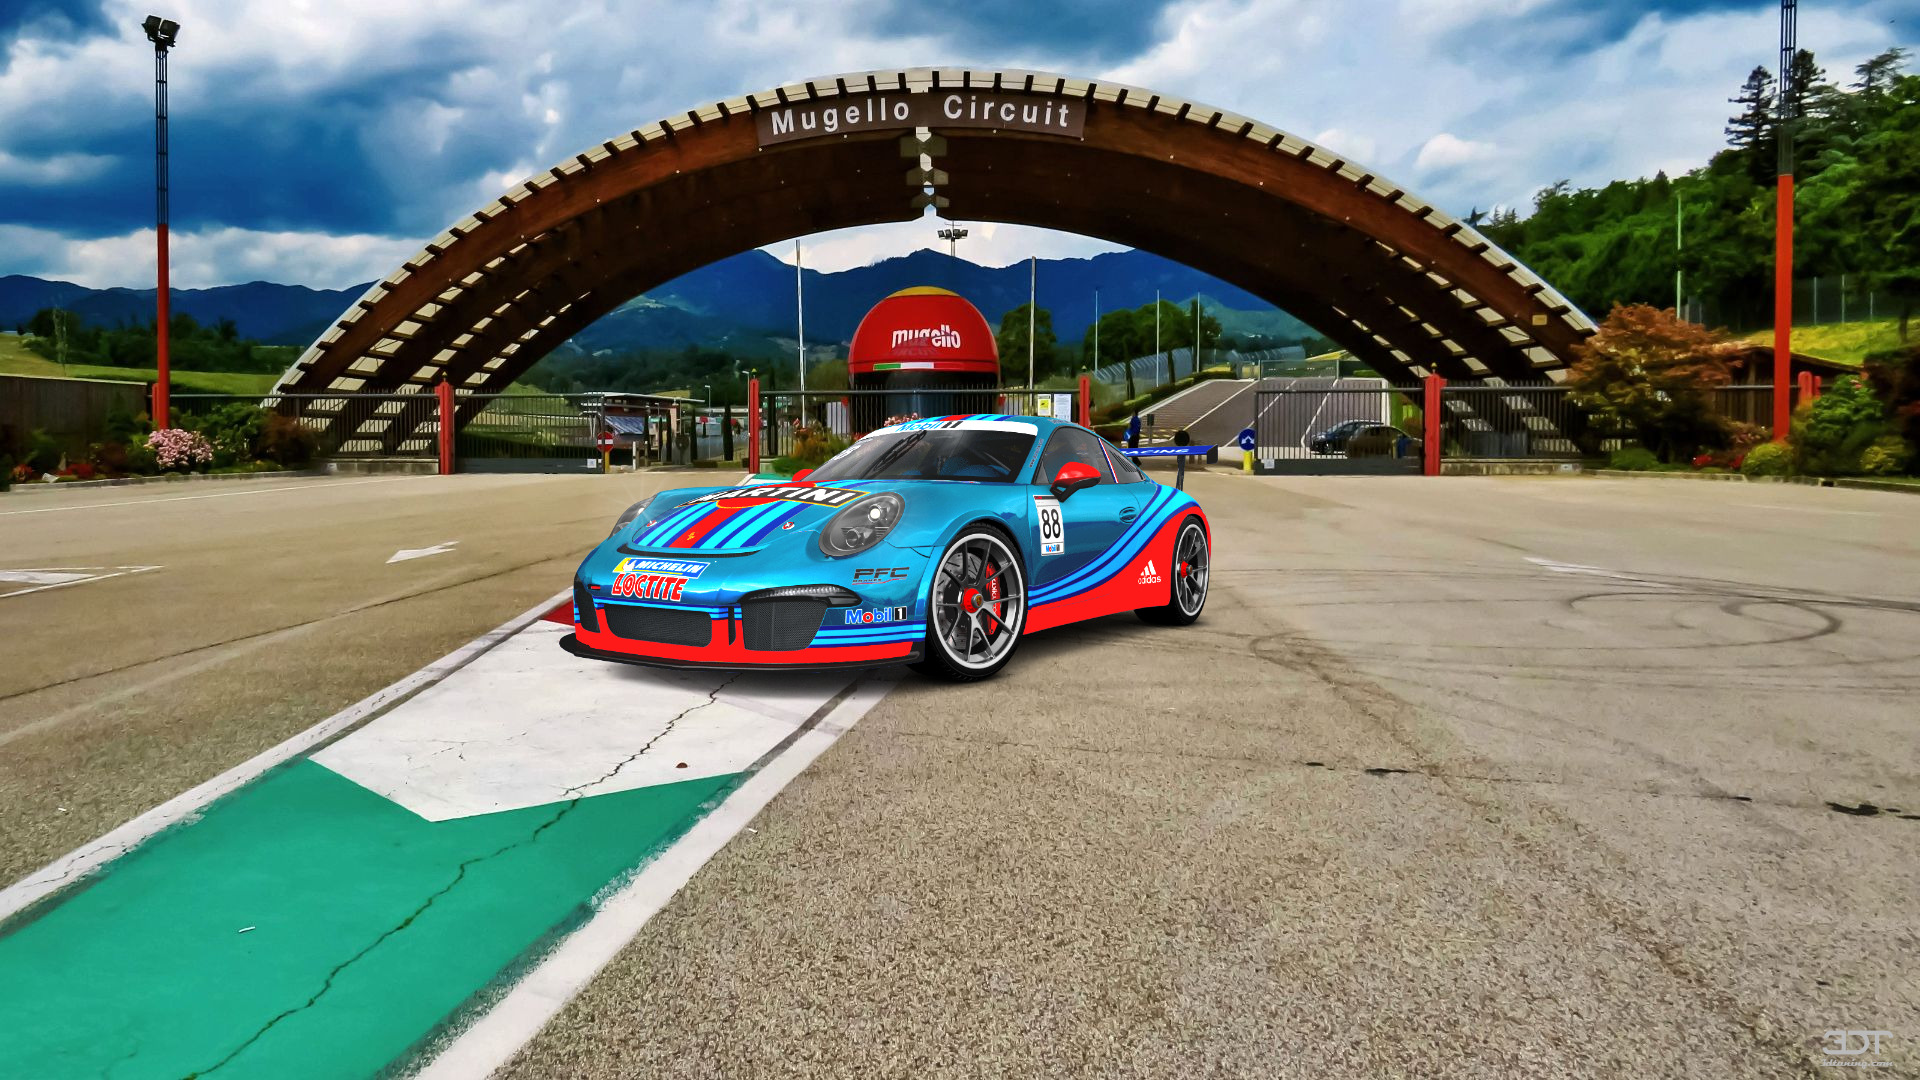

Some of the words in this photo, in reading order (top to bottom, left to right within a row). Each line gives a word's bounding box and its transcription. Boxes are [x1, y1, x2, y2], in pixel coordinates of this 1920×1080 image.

[771, 98, 910, 135] Mugello
[944, 94, 1070, 128] Circuit
[892, 324, 961, 349] mugello
[895, 420, 945, 432] Mobil
[1041, 508, 1061, 540] 88
[634, 560, 704, 574] MICHELIN
[853, 566, 910, 579] PFC
[611, 573, 690, 602] LOCTITE
[1137, 574, 1162, 585] adidas
[845, 606, 893, 625] Mobil
